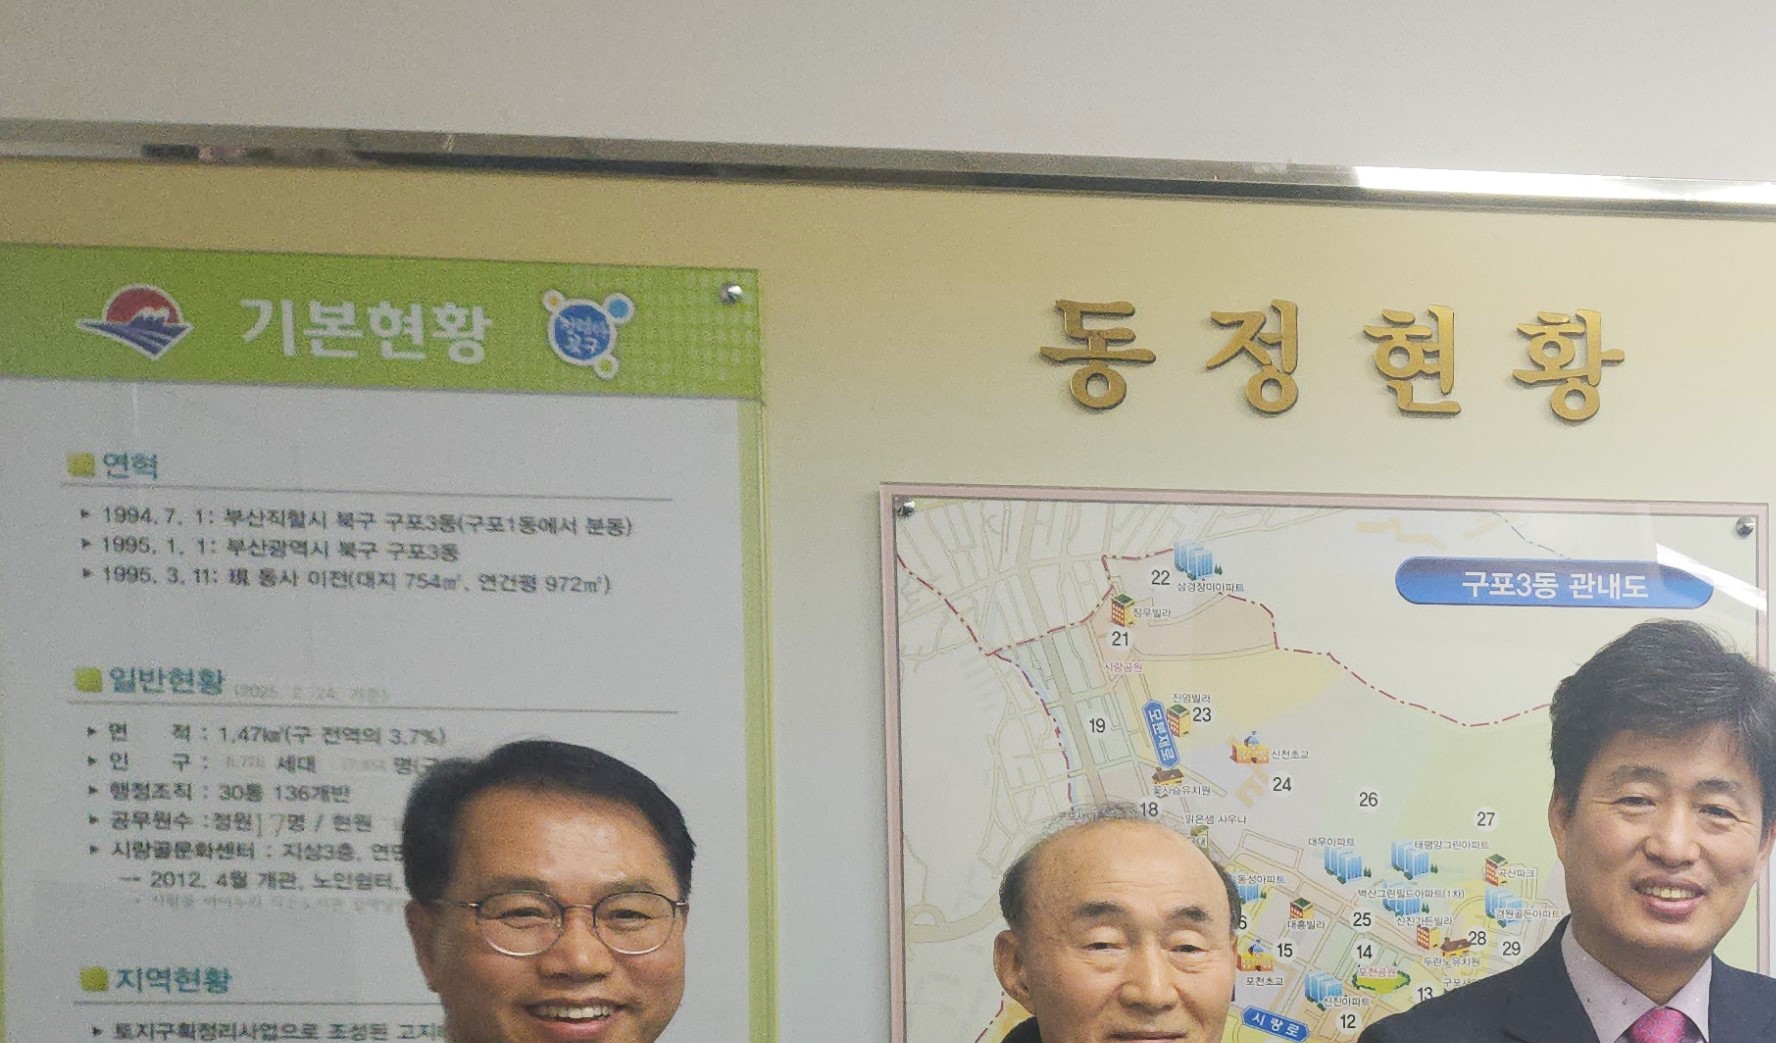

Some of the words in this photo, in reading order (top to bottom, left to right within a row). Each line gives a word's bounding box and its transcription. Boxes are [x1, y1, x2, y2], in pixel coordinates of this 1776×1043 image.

[240, 298, 493, 365] 기본현황
[103, 451, 158, 480] 연혁
[1151, 570, 1171, 585] 22
[1462, 571, 1559, 599] 구포3동
[1568, 572, 1649, 599] 관내도
[1111, 630, 1129, 646] 21
[109, 667, 226, 695] 일반현황
[1192, 707, 1212, 721] 23
[1089, 718, 1106, 733] 19
[1272, 777, 1292, 792] 24
[1359, 792, 1378, 807] 26
[1140, 802, 1159, 816] 18
[1477, 811, 1496, 826] 27
[1353, 912, 1372, 927] 25
[1468, 931, 1487, 946] 28
[1276, 944, 1293, 957] 15
[1356, 945, 1373, 958] 14
[1502, 941, 1521, 956] 29
[115, 966, 233, 994] 지역현황
[1252, 1011, 1300, 1038] 시랑로
[1339, 1014, 1356, 1029] 12
